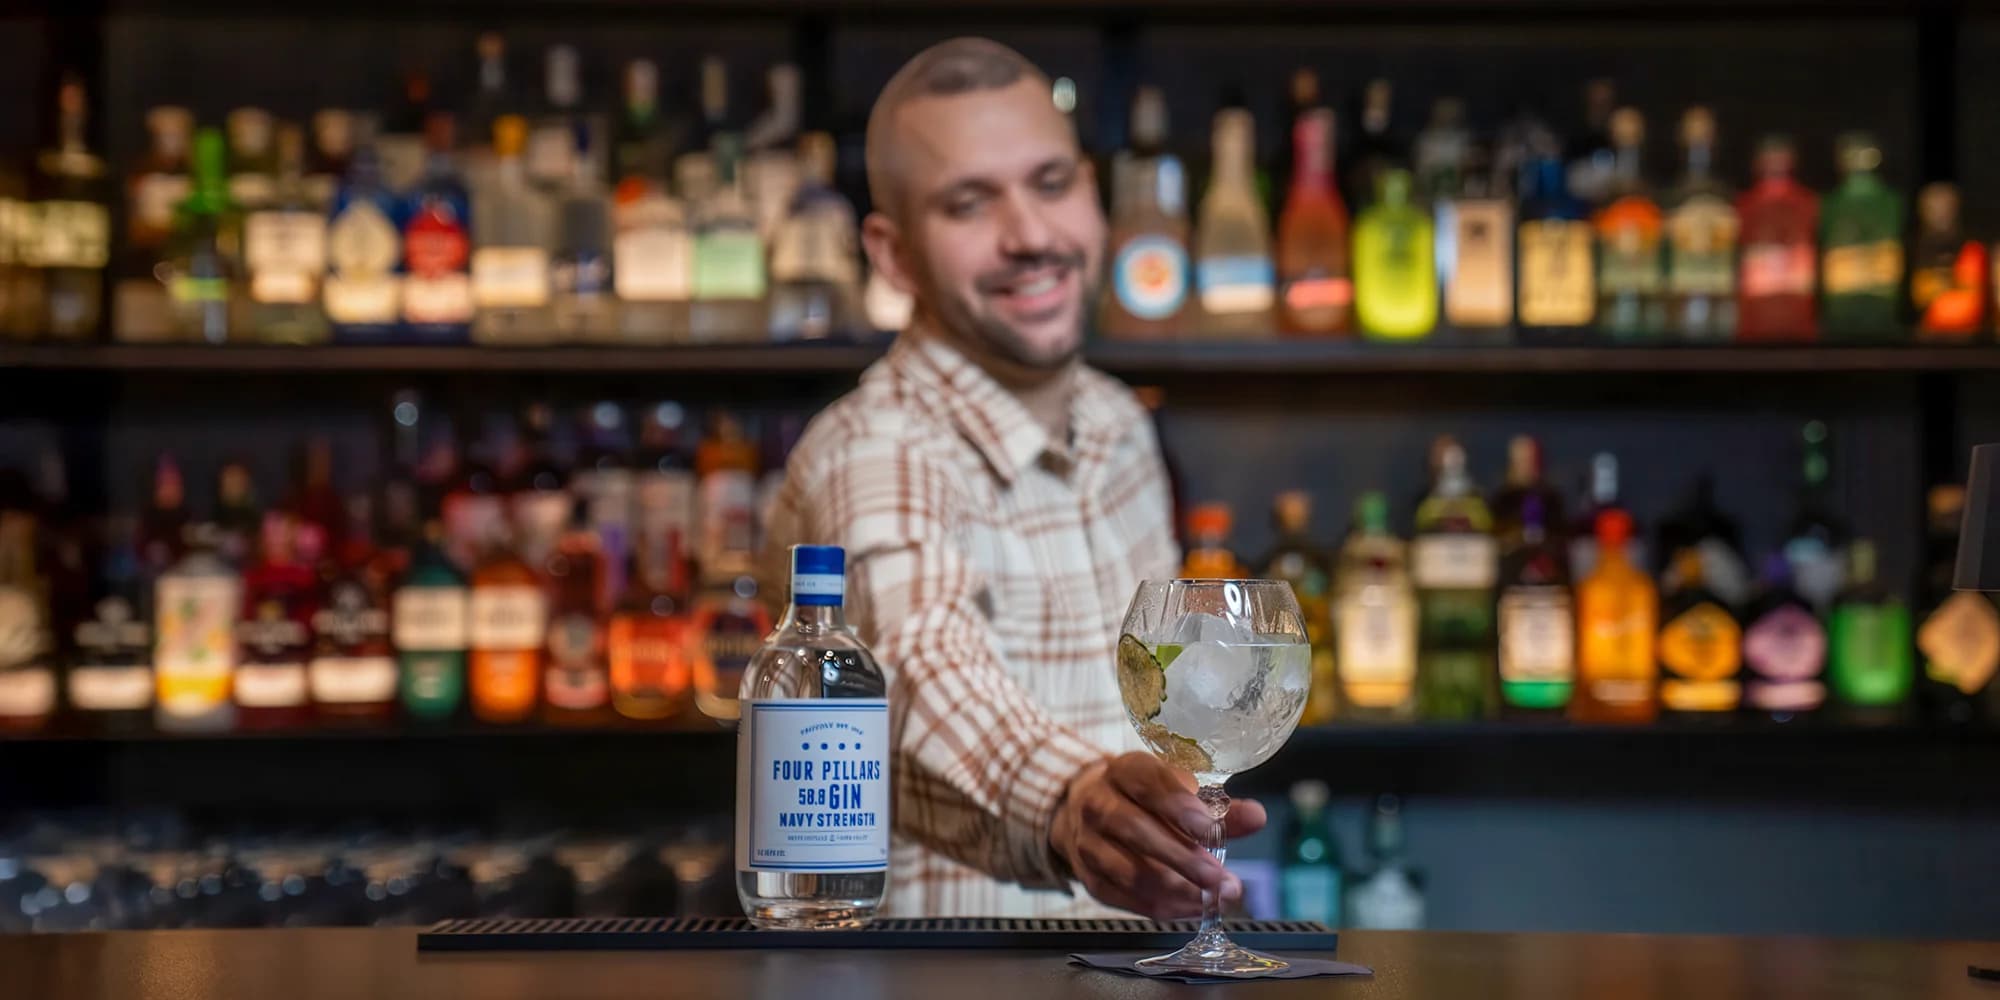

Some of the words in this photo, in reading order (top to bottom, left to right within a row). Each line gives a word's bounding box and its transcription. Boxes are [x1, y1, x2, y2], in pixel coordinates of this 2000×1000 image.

[773, 760, 814, 781] FOUR
[822, 760, 880, 781] PILLARS
[798, 788, 826, 806] 58.8
[829, 783, 862, 810] GIN
[779, 812, 814, 828] NAVY
[816, 812, 876, 827] STRENGTH
